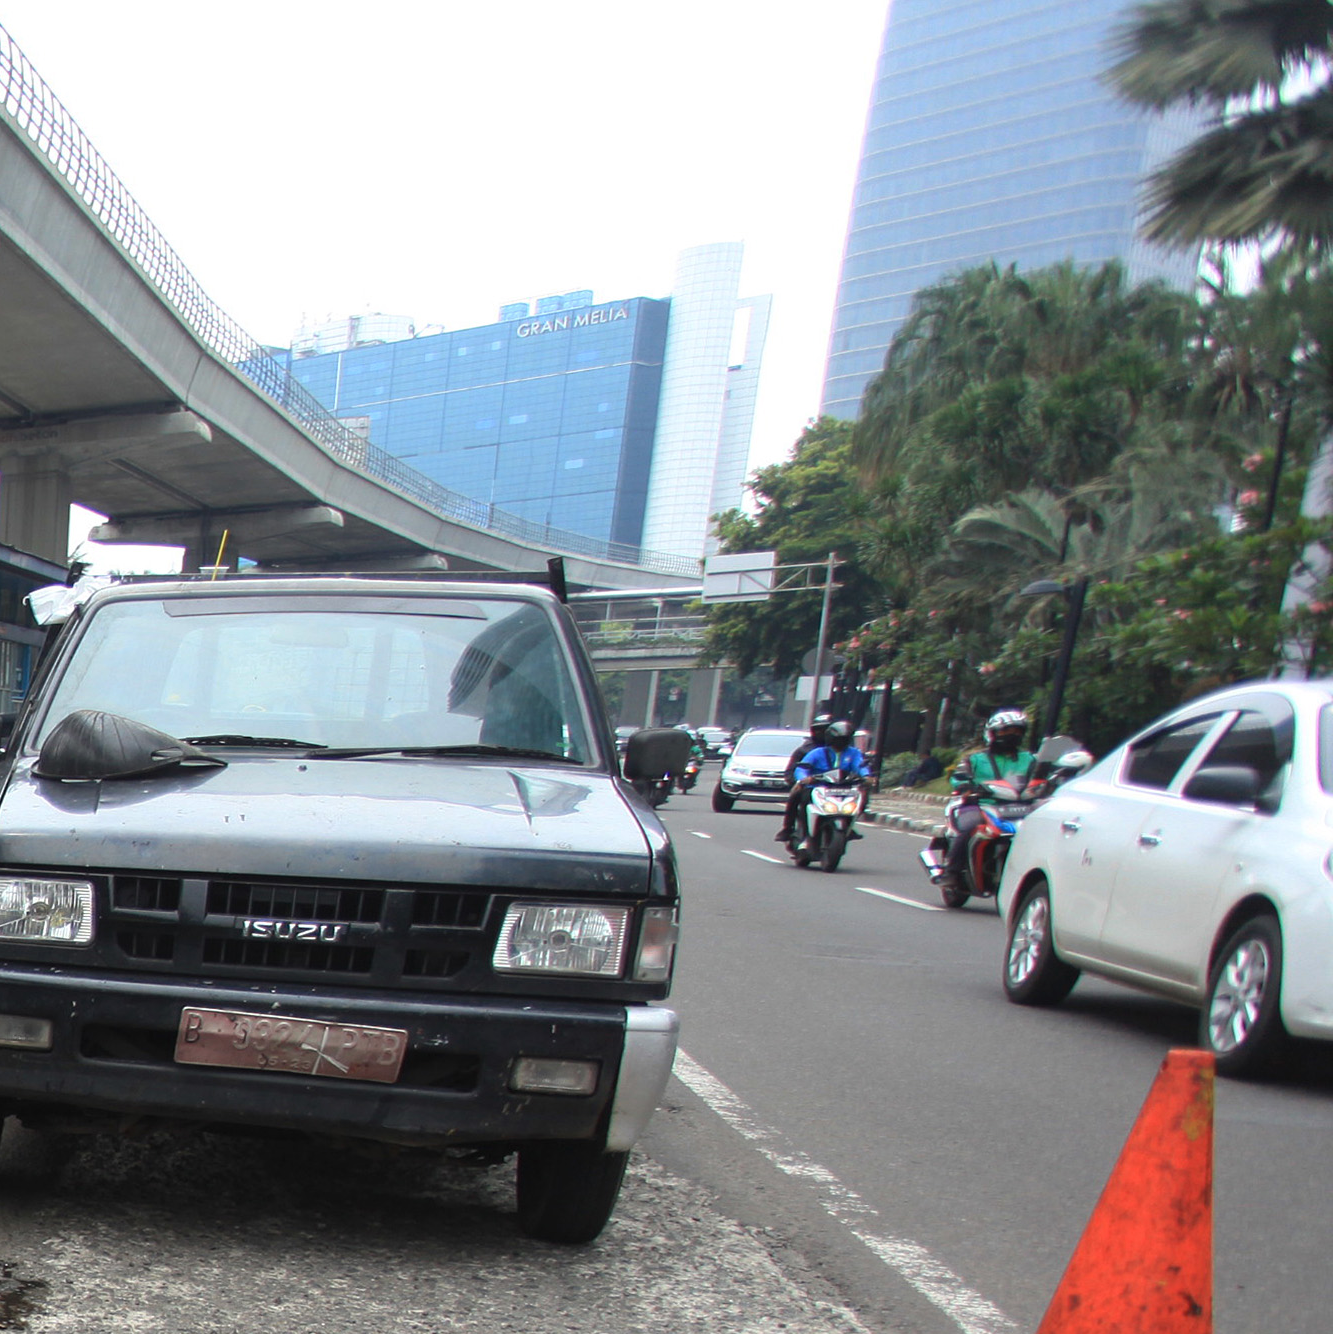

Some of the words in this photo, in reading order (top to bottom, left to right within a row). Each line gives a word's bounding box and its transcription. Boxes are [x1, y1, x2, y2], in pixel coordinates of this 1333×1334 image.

[516, 316, 569, 338] GRAN
[574, 307, 628, 328] MELIA
[243, 920, 342, 941] ISUZU
[185, 1012, 203, 1043] B
